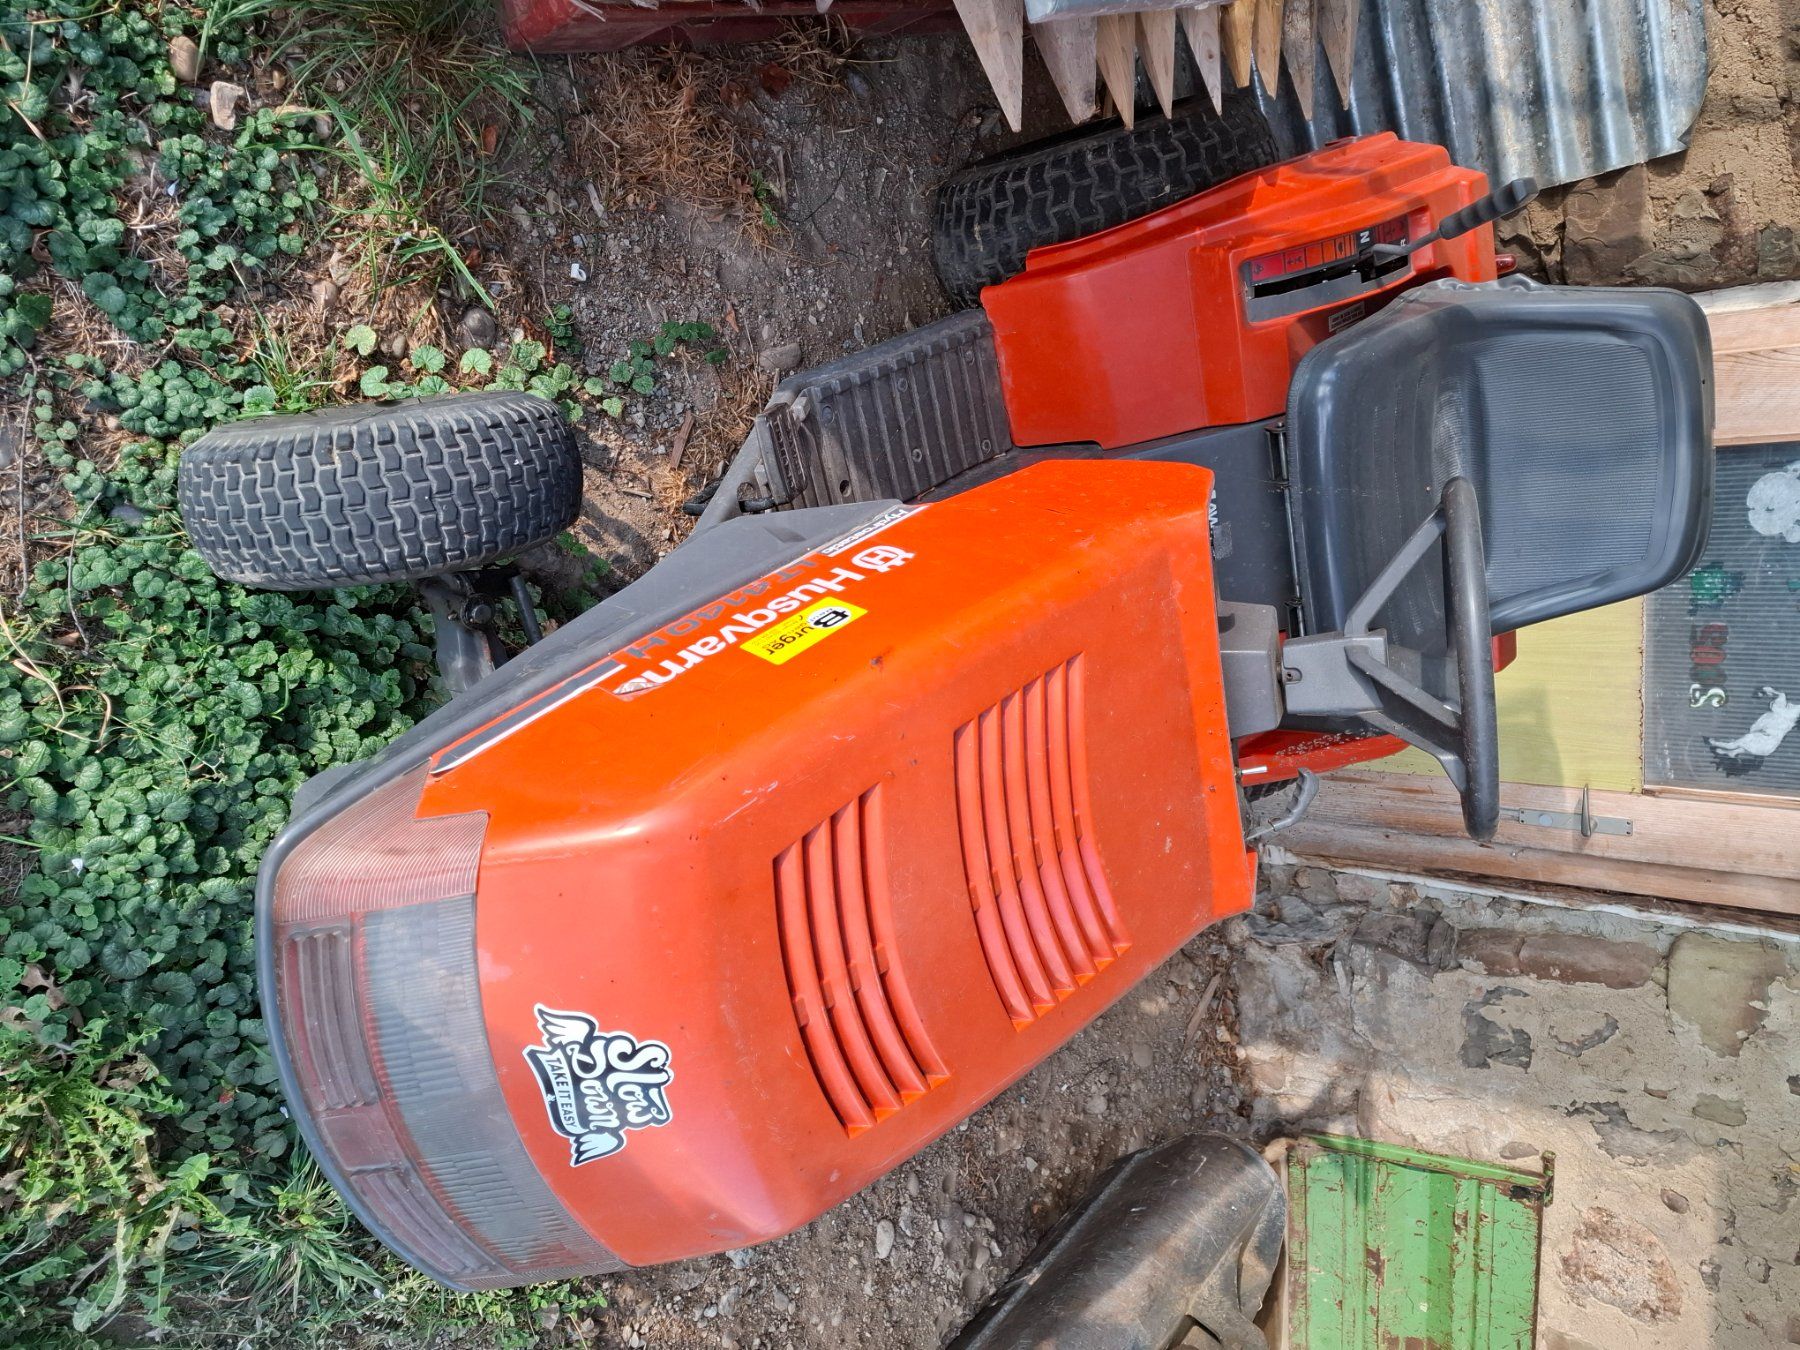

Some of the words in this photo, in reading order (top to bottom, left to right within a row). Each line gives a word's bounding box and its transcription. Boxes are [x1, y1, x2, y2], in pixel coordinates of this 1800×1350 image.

[1360, 231, 1370, 243] N
[765, 610, 849, 655] Burger
[545, 1056, 569, 1088] TAKE
[566, 1040, 620, 1130] Down
[607, 1038, 668, 1123] Slow
[557, 1088, 572, 1101] IT
[560, 1102, 576, 1128] EASY
